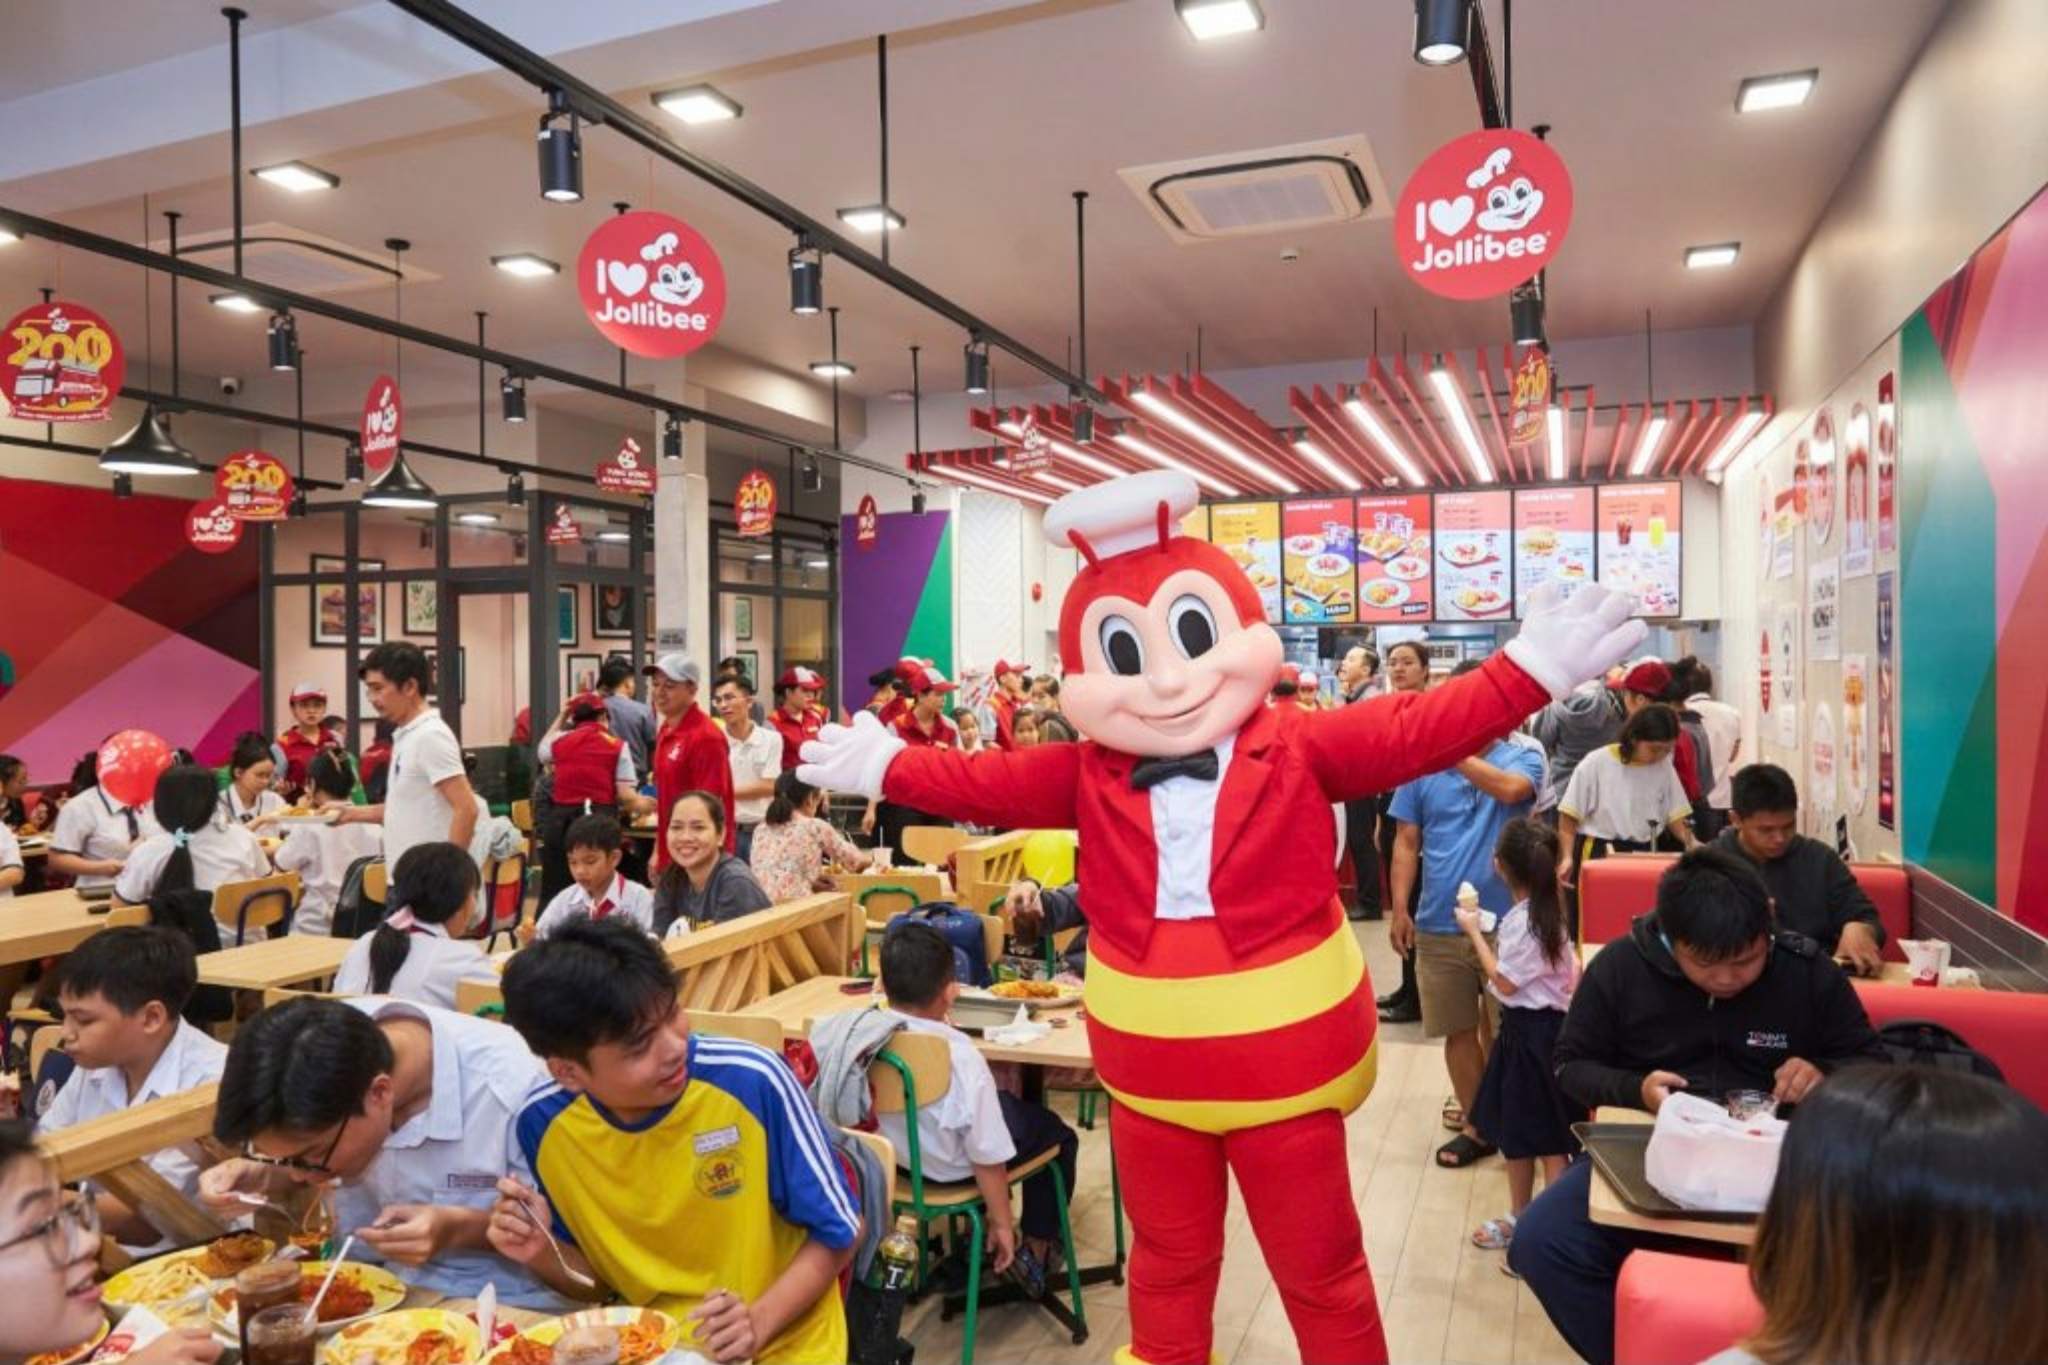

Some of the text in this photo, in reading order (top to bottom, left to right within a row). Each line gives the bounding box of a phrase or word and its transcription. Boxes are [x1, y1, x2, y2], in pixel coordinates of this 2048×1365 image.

[1416, 202, 1426, 242] I
[1412, 233, 1548, 272] Jollibee
[597, 258, 607, 294] I
[595, 298, 708, 331] Jollibee
[8, 327, 113, 368] 200
[222, 464, 286, 489] 200
